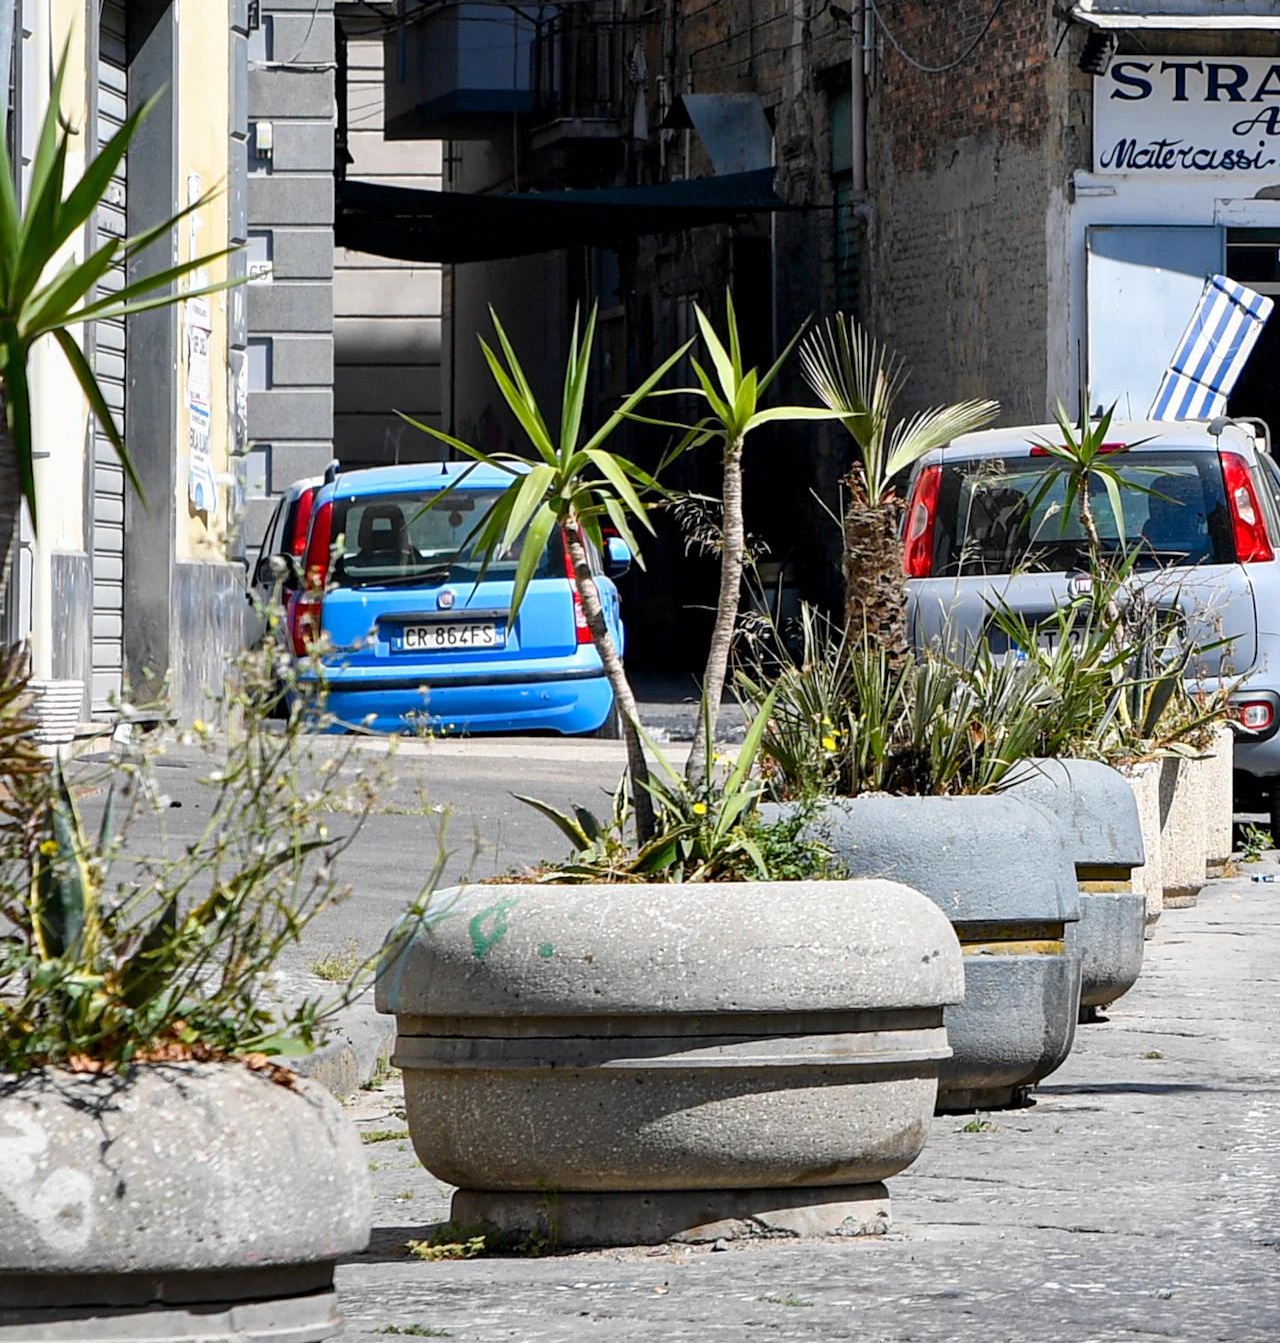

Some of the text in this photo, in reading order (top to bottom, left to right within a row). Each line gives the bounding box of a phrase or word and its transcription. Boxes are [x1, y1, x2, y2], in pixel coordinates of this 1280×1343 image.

[1100, 138, 1277, 171] Materassi
[250, 265, 268, 281] 65
[406, 625, 493, 647] CR 864FS
